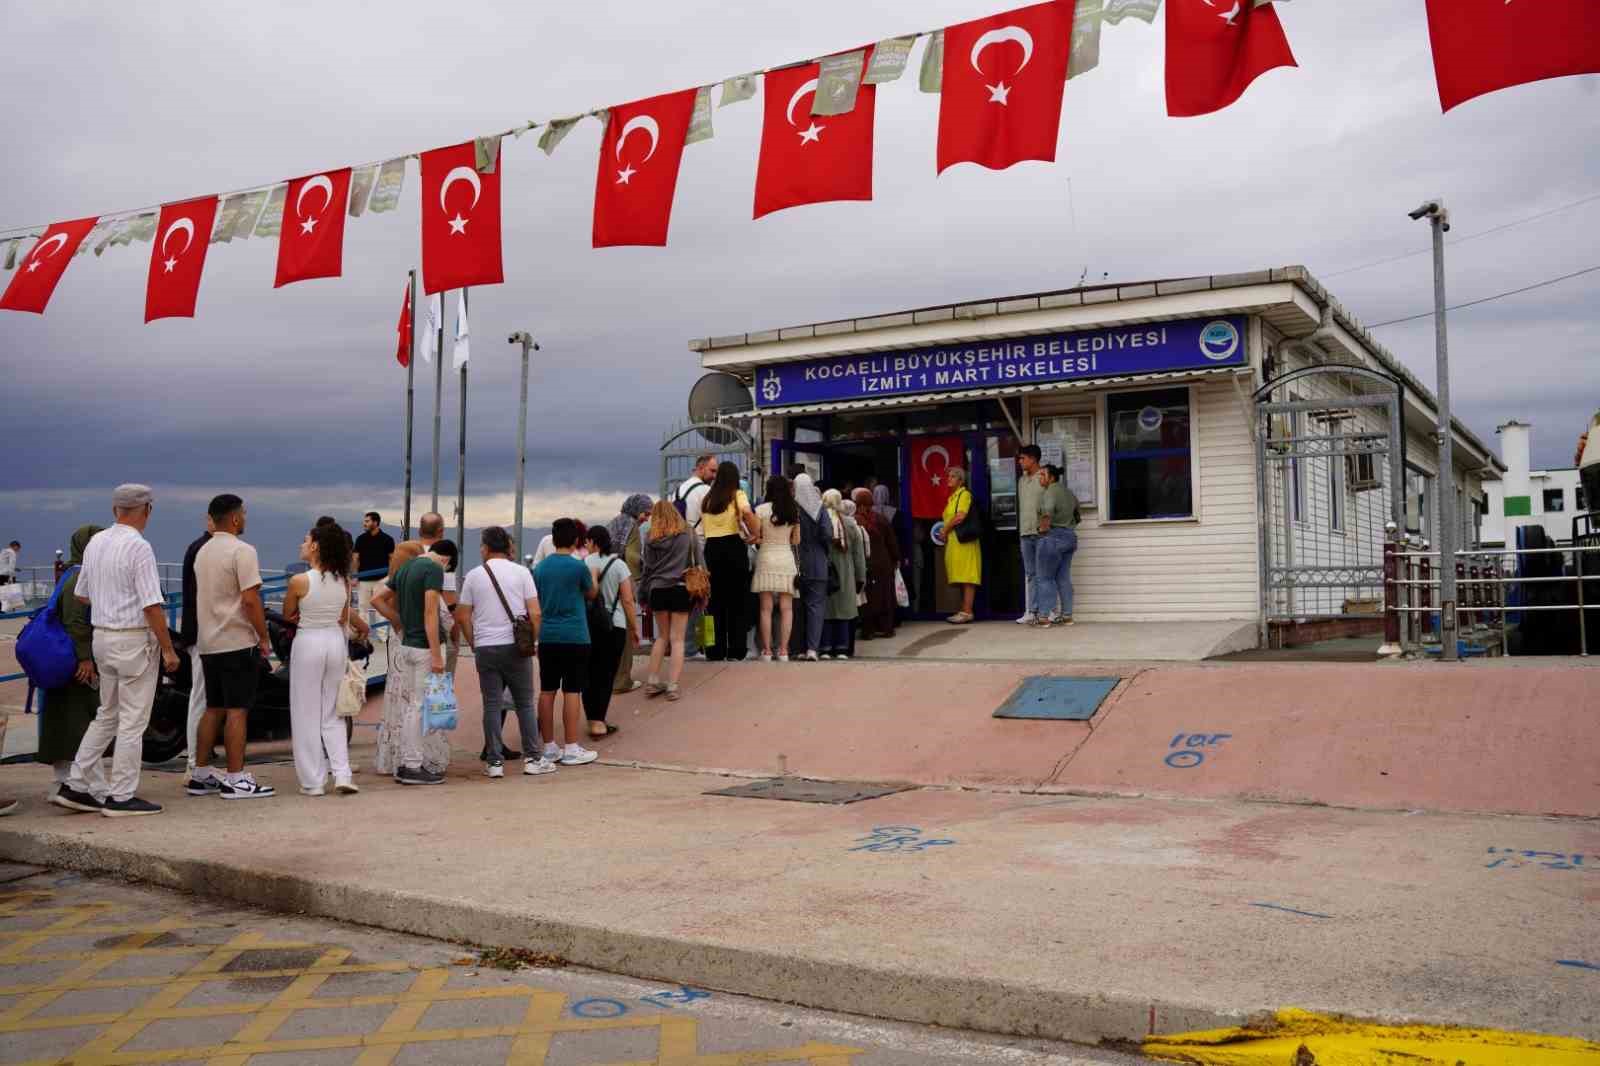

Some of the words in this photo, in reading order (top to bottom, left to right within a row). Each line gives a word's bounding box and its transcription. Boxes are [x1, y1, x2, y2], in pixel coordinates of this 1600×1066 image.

[805, 356, 887, 381] KOCAELİ
[894, 344, 1026, 371] BÜYÜKŞEHİR
[1034, 328, 1166, 357] BELEDİYESİ
[862, 373, 912, 392] İZMİT
[920, 374, 927, 387] 1
[935, 367, 992, 385] MART
[998, 353, 1097, 379] İSKELESİ
